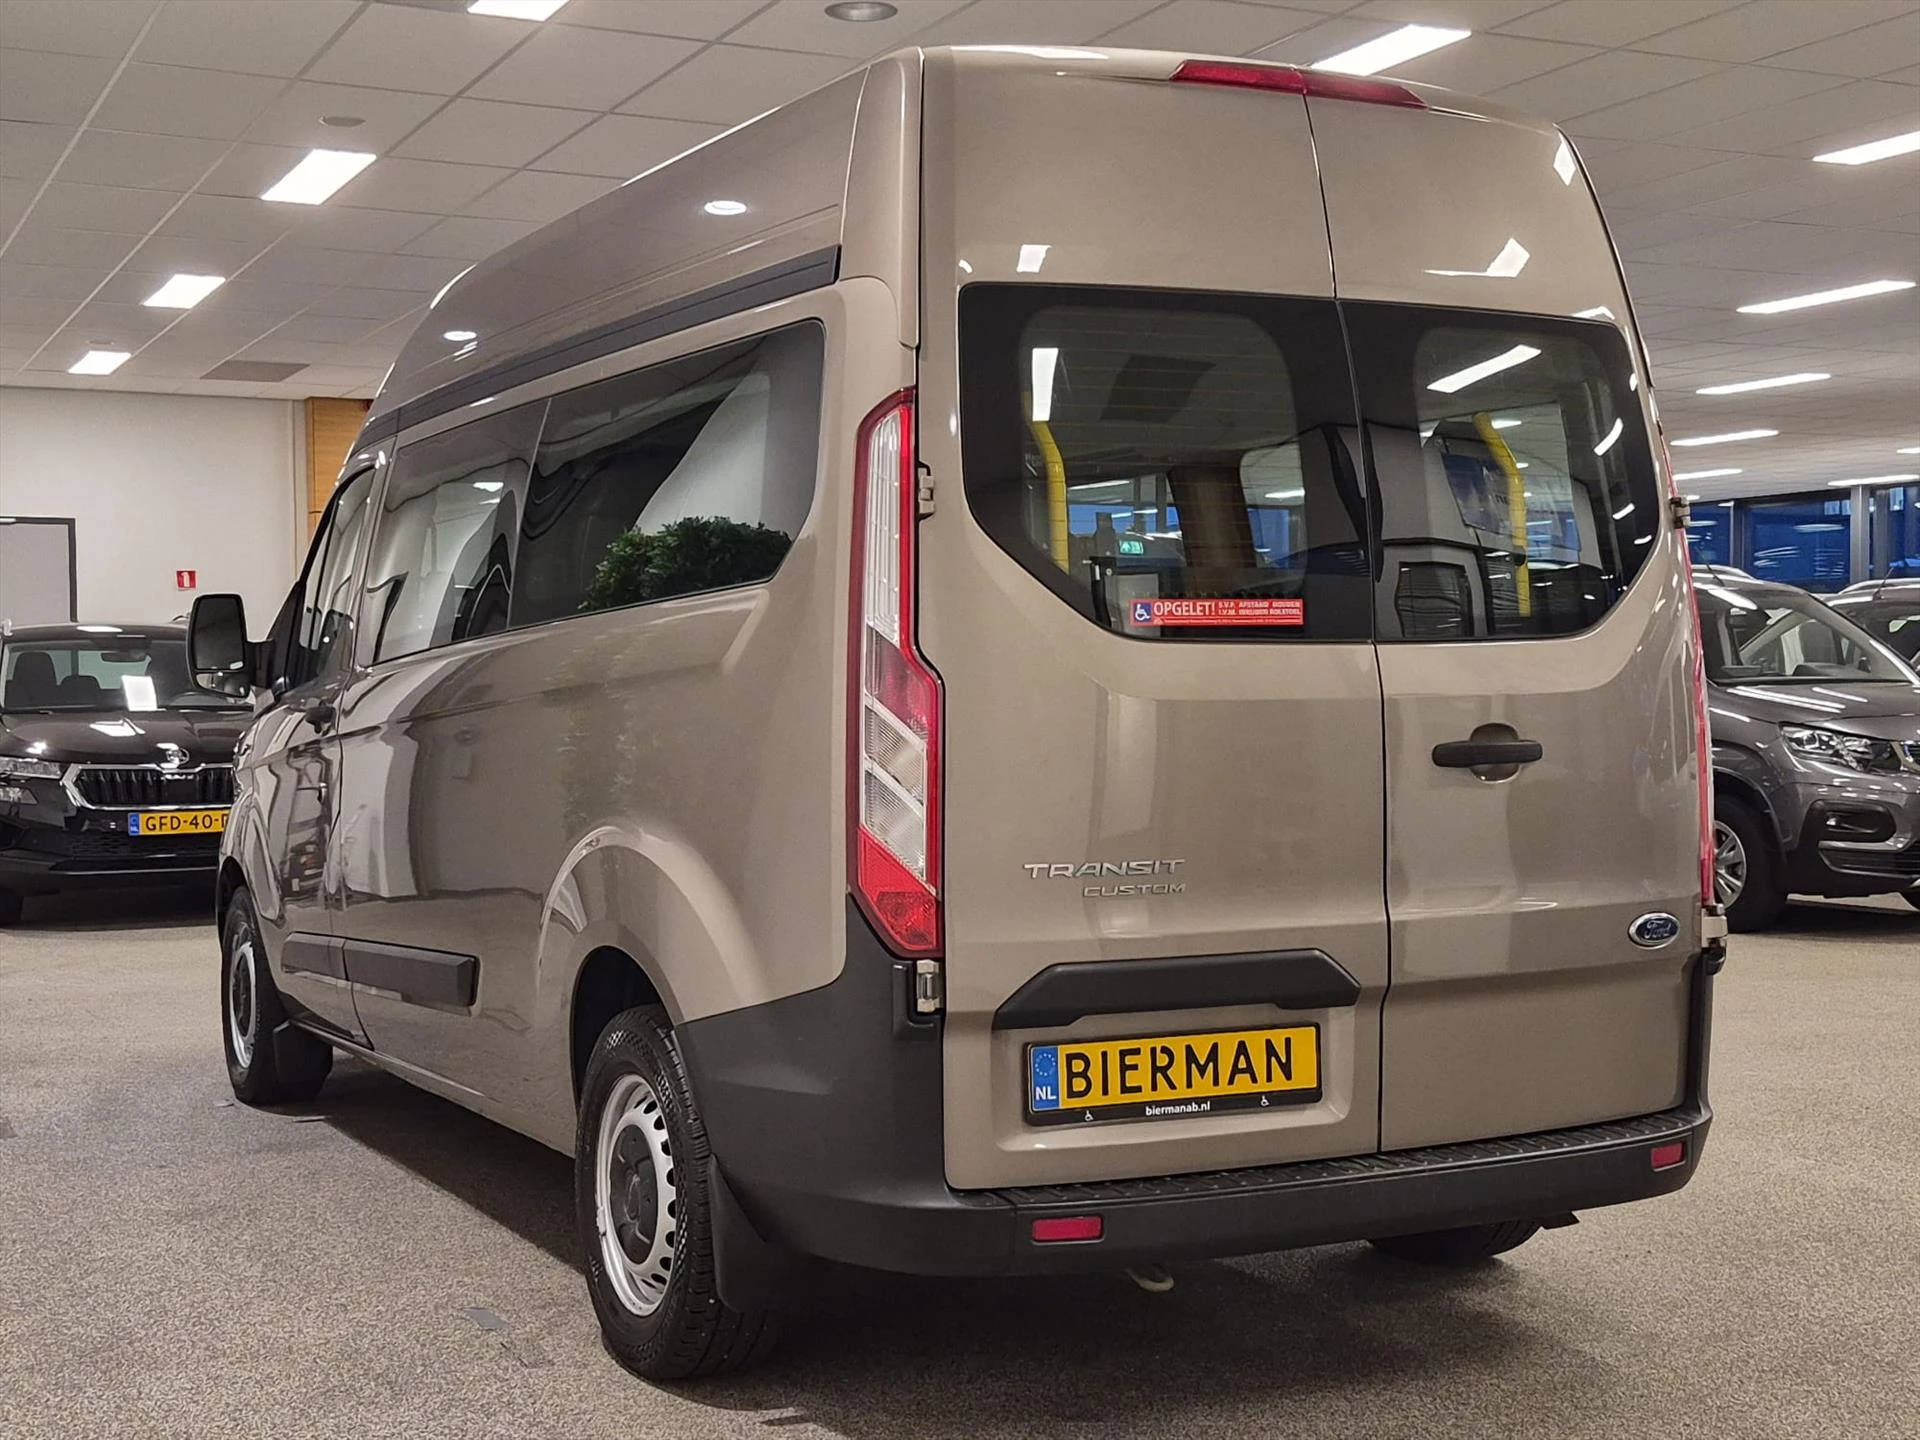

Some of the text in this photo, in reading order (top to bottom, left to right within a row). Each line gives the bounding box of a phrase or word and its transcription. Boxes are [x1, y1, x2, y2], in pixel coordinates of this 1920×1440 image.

[1153, 601, 1215, 616] OPGELET!
[1023, 859, 1186, 879] TRANSIT
[1083, 883, 1186, 898] CUSTOM
[1035, 1036, 1293, 1101] NL BIERMAN
[1145, 1101, 1211, 1116] biermanab.nl
